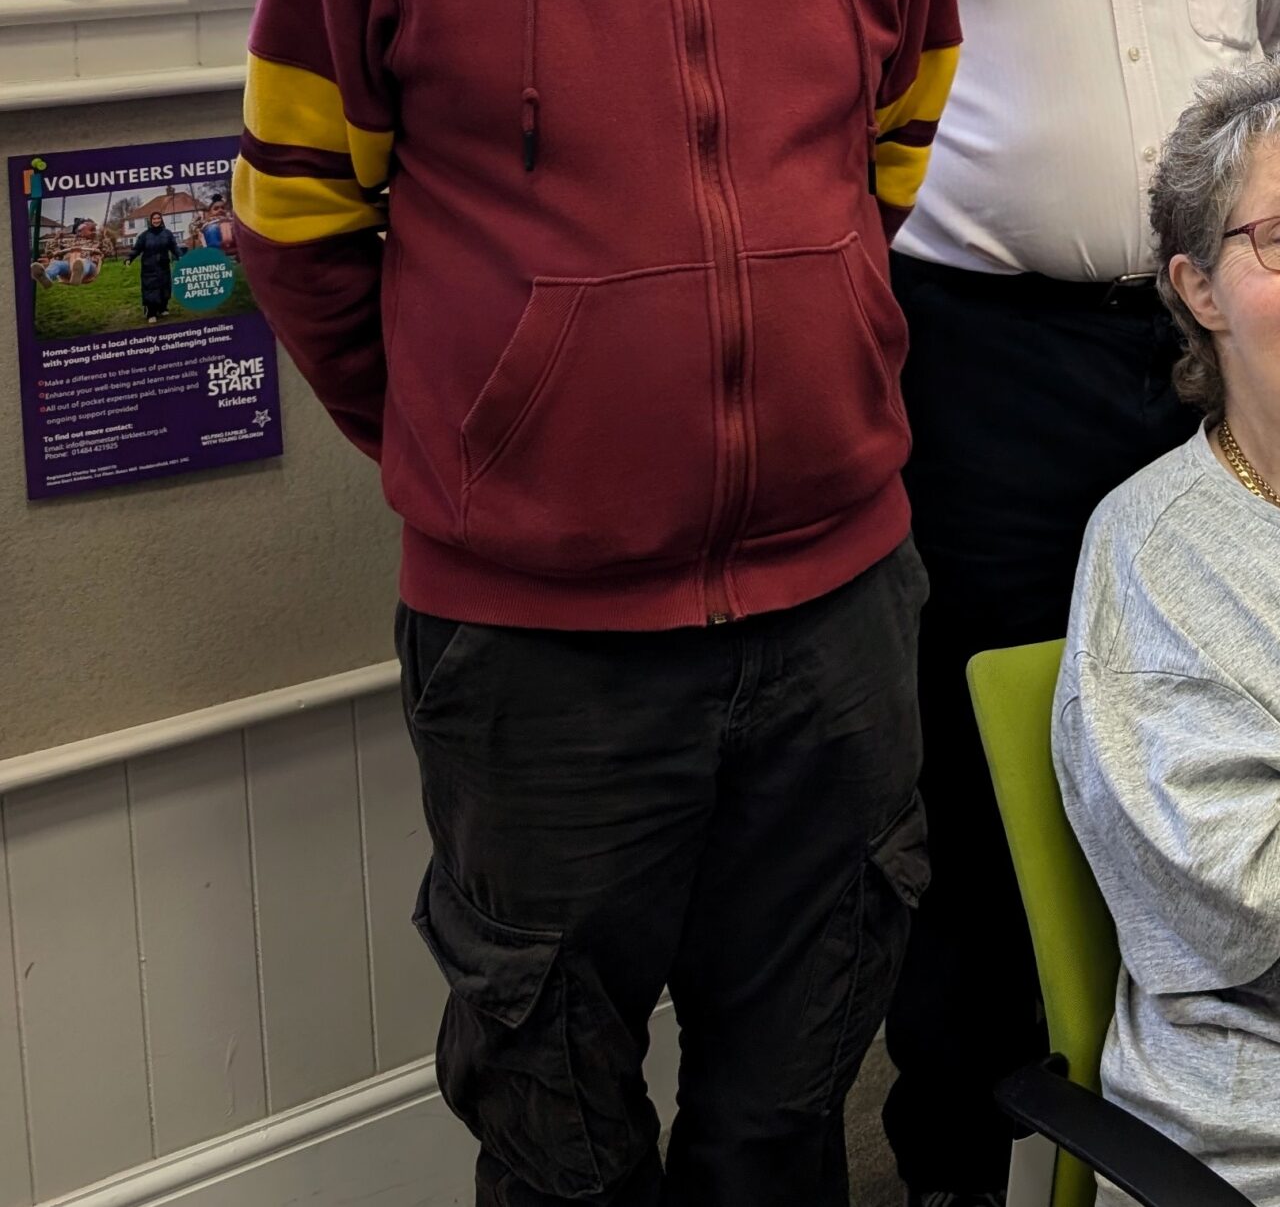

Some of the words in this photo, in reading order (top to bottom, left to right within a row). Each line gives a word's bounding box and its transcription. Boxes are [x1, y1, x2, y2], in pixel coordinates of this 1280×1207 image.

[44, 165, 174, 191] VOLUNTEERS
[174, 272, 220, 285] STARTING
[221, 270, 233, 279] IN
[180, 263, 226, 276] TRAINING
[184, 288, 211, 299] APRIL
[212, 286, 224, 295] 24
[187, 280, 221, 291] BATLEY
[42, 344, 91, 358] Home-Start
[92, 343, 100, 351] is
[108, 338, 128, 348] local
[129, 334, 157, 346] charity
[158, 326, 202, 341] supporting
[203, 324, 234, 334] families
[43, 359, 62, 368] with
[64, 356, 90, 367] young
[92, 350, 125, 361] children
[126, 345, 160, 356] through
[161, 338, 207, 350] challenging
[208, 334, 232, 344] times.
[44, 378, 64, 387] Make
[72, 372, 108, 383] difference
[118, 368, 130, 376] the
[131, 366, 147, 374] lives
[148, 364, 156, 372] of
[157, 360, 184, 370] parents
[184, 358, 198, 366] and
[199, 354, 226, 364] children
[207, 357, 265, 380] HOME
[45, 390, 75, 400] Enhance
[76, 388, 92, 396] your
[94, 382, 131, 392] well-being
[147, 376, 165, 384] learn
[182, 370, 198, 378] skills
[208, 374, 265, 396] START
[57, 403, 70, 412] out
[71, 400, 80, 408] of
[80, 397, 105, 408] pocket
[106, 393, 138, 404] expenses
[158, 385, 185, 395] training
[186, 382, 200, 390] and
[218, 395, 258, 408] Kirklees
[46, 414, 77, 425] ongoing
[78, 410, 106, 420] support
[107, 404, 139, 416] provided
[55, 433, 70, 441] find
[71, 431, 84, 439] out
[85, 428, 104, 436] more
[105, 423, 134, 433] contact:
